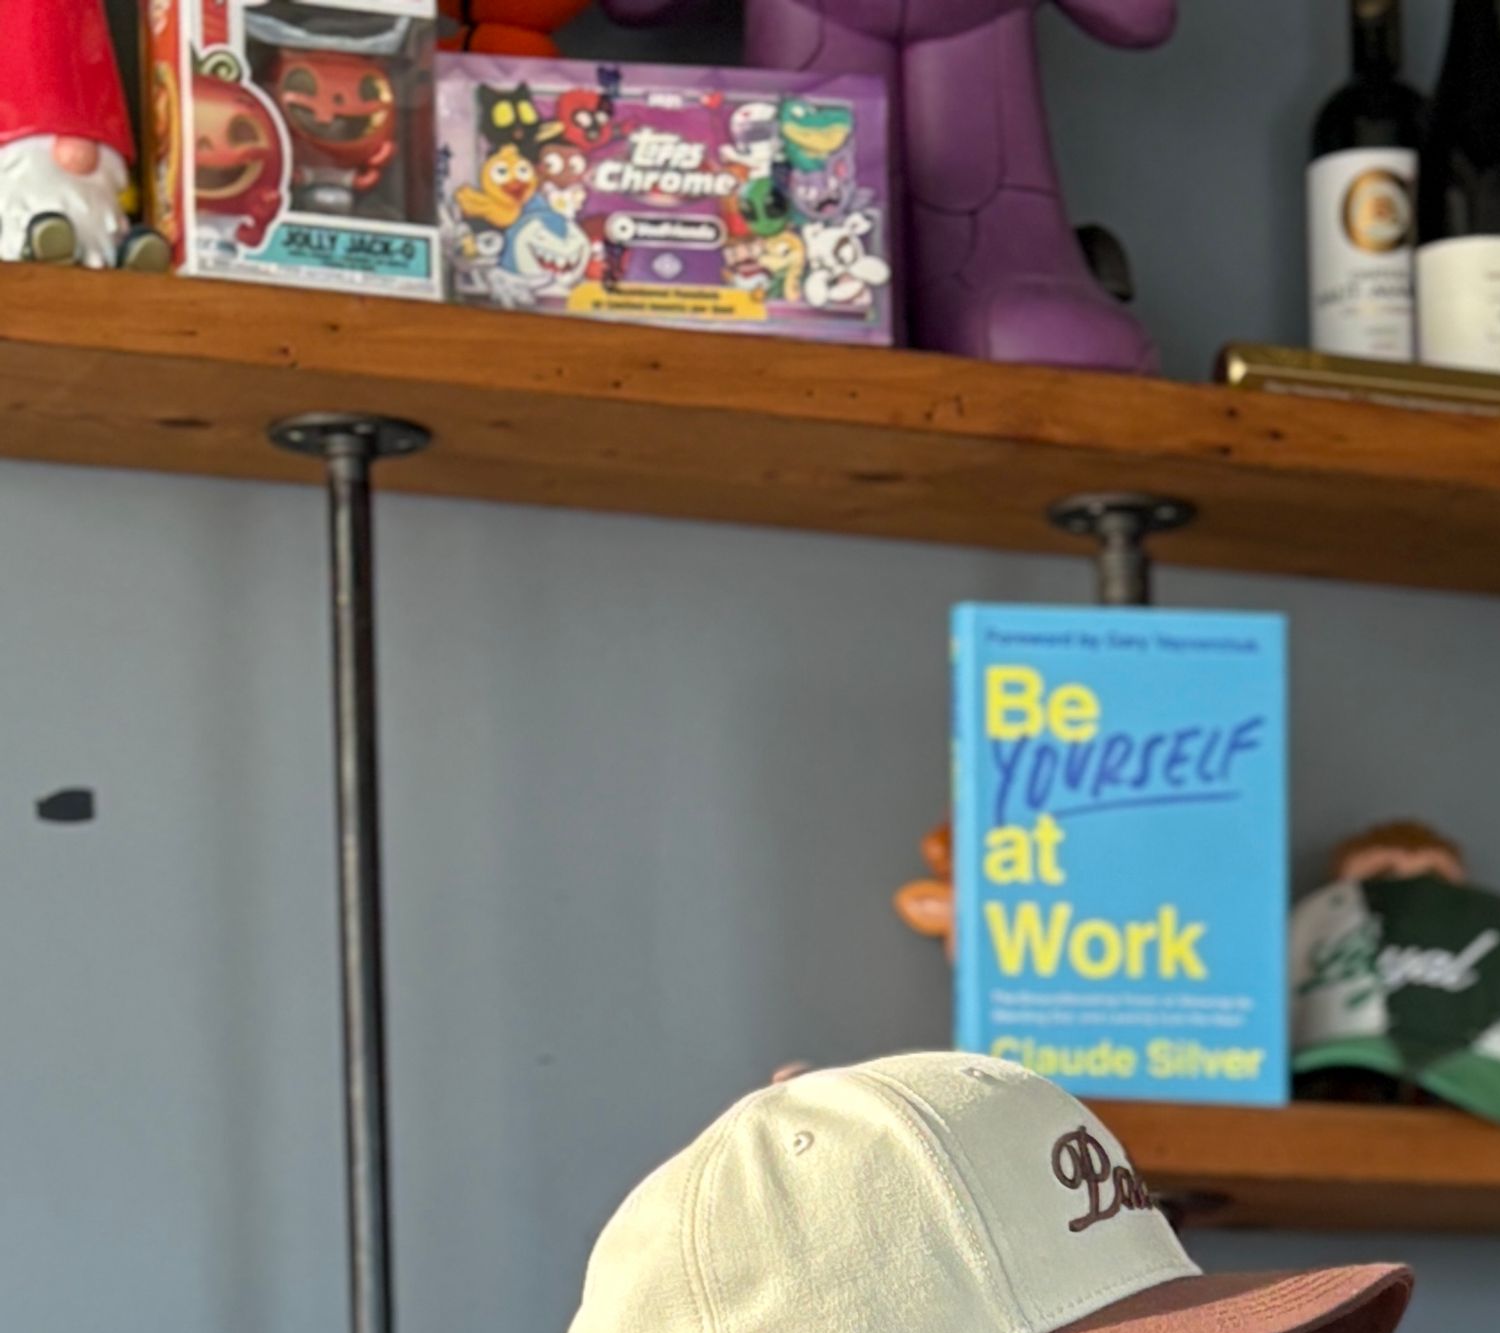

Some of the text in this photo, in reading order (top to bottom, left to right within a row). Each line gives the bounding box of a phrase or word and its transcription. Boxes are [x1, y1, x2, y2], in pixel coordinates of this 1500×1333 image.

[594, 160, 739, 197] Chrome
[283, 229, 338, 251] JOLLY
[984, 664, 1101, 743] Be
[990, 714, 1267, 829] YOURSELF
[982, 812, 1066, 887] at
[983, 900, 1209, 981] Work
[1145, 1037, 1267, 1082] Silver
